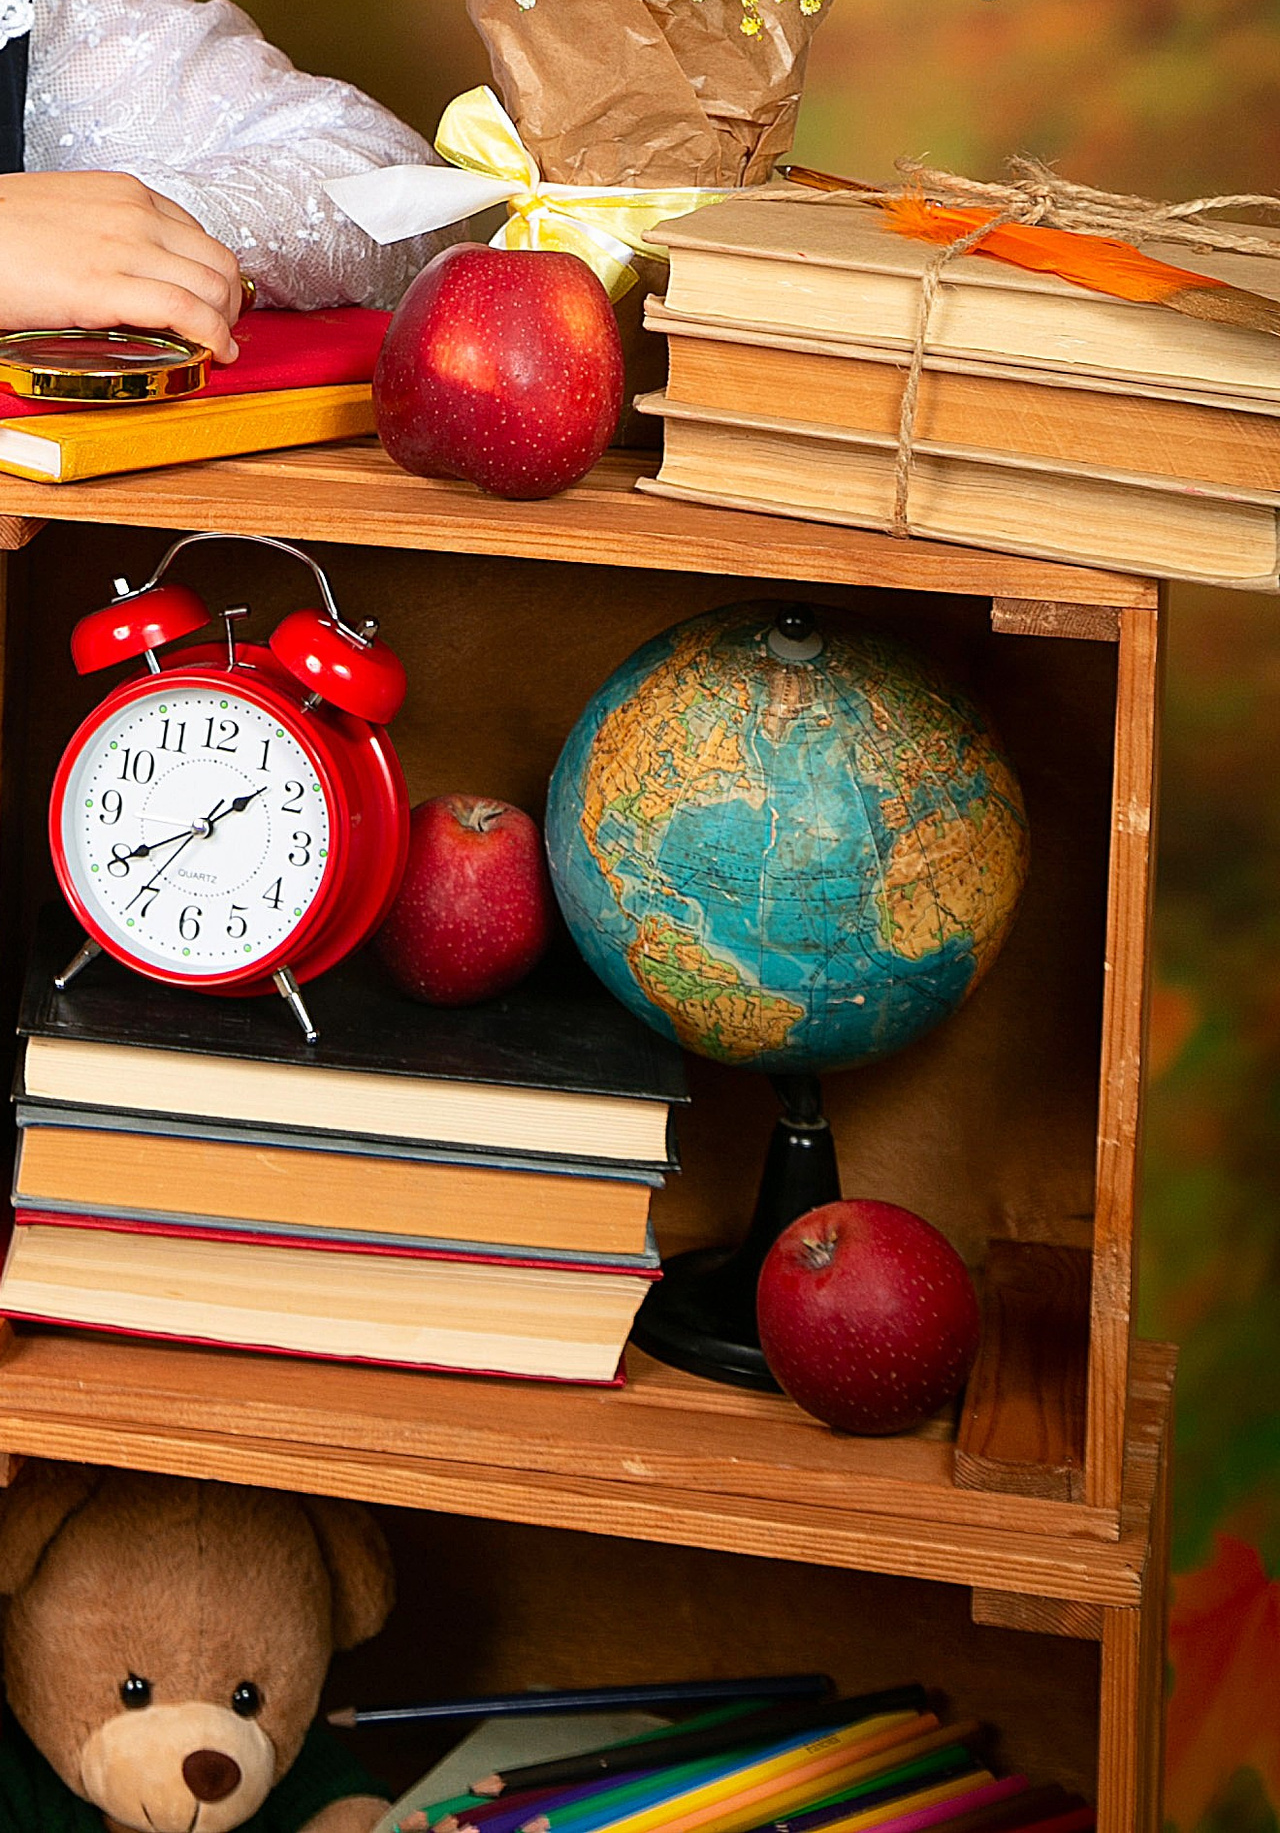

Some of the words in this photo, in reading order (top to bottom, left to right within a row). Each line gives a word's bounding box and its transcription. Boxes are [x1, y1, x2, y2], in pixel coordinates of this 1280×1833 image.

[156, 718, 187, 755] 11
[201, 716, 240, 754] 12
[116, 746, 155, 785] 10
[256, 738, 271, 772] 1
[99, 789, 123, 825] 9
[280, 780, 305, 815] 2
[107, 843, 131, 878] 8
[288, 830, 312, 867] 3
[177, 868, 218, 885] QUARTZ
[262, 876, 284, 911] 4
[140, 885, 161, 919] 7
[178, 905, 203, 941] 6
[226, 904, 248, 939] 5
